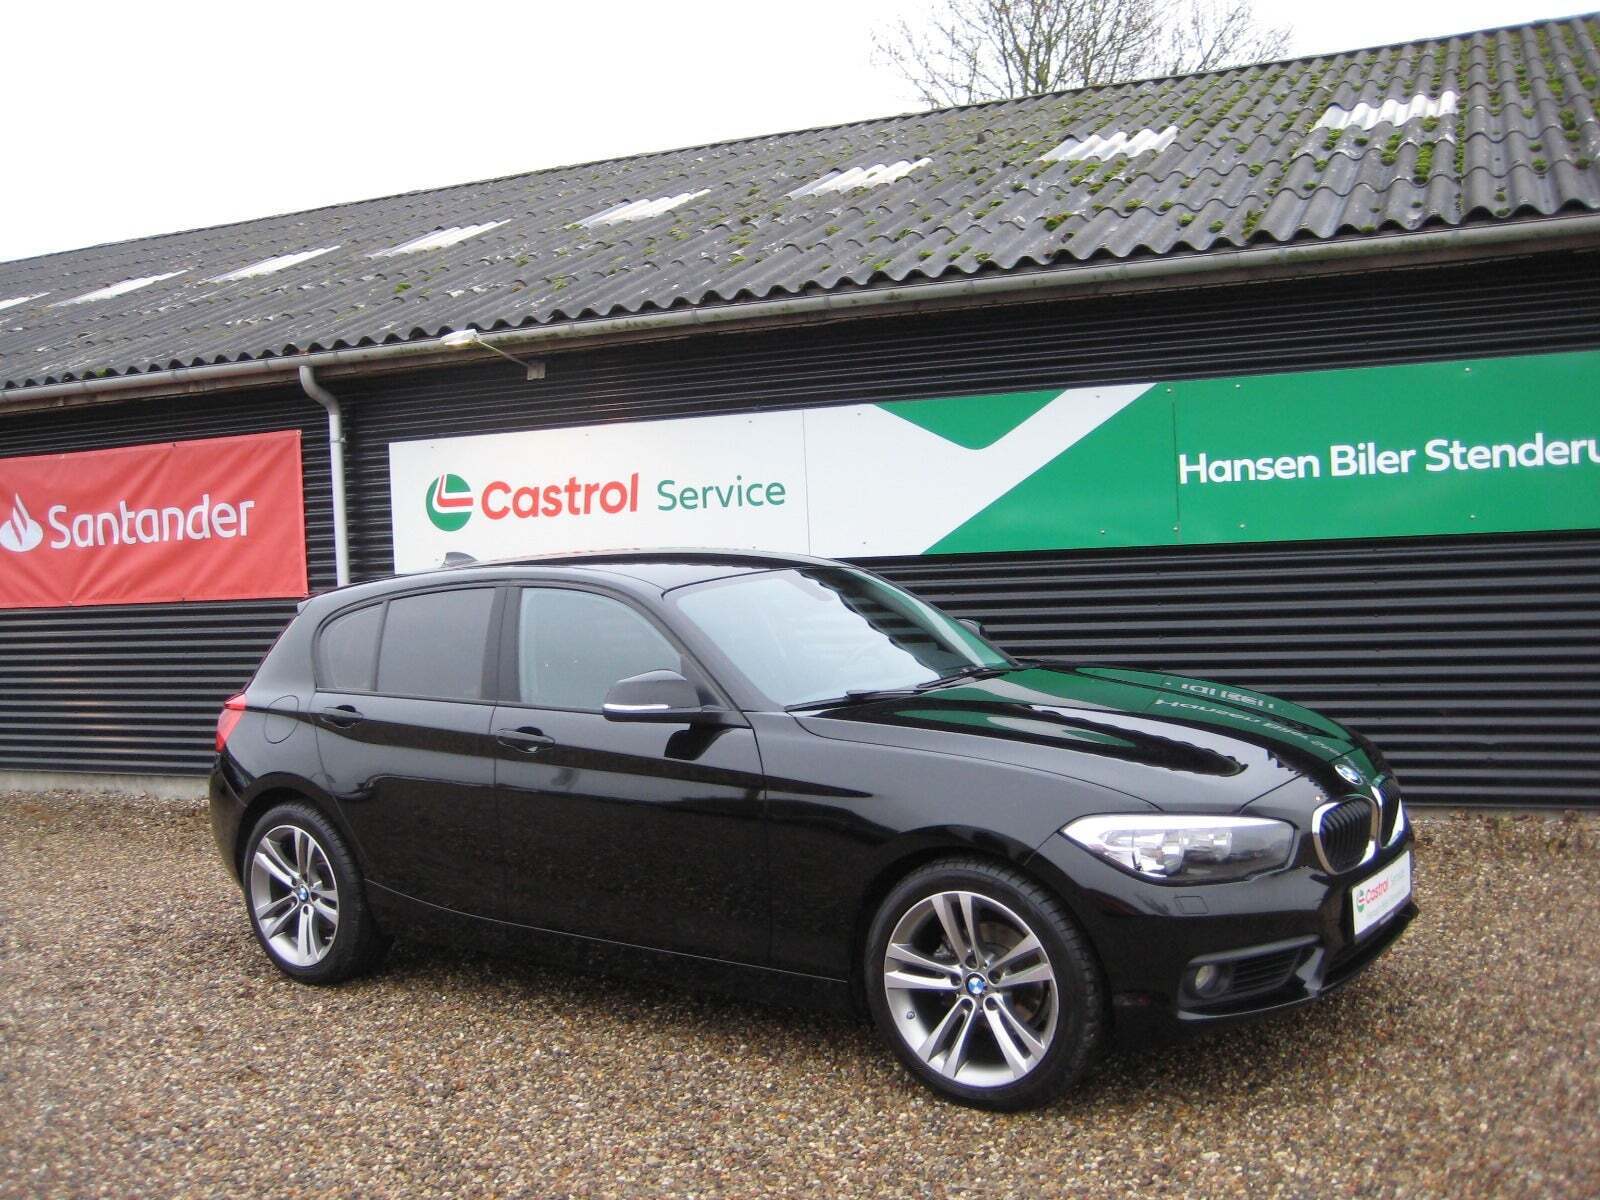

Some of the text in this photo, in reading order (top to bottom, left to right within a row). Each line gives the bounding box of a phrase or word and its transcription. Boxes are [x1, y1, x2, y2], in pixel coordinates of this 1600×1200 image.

[1178, 452, 1321, 484] Hansen
[1329, 441, 1417, 477] Biler
[481, 472, 786, 520] Castrol Service
[48, 493, 255, 550] Santander
